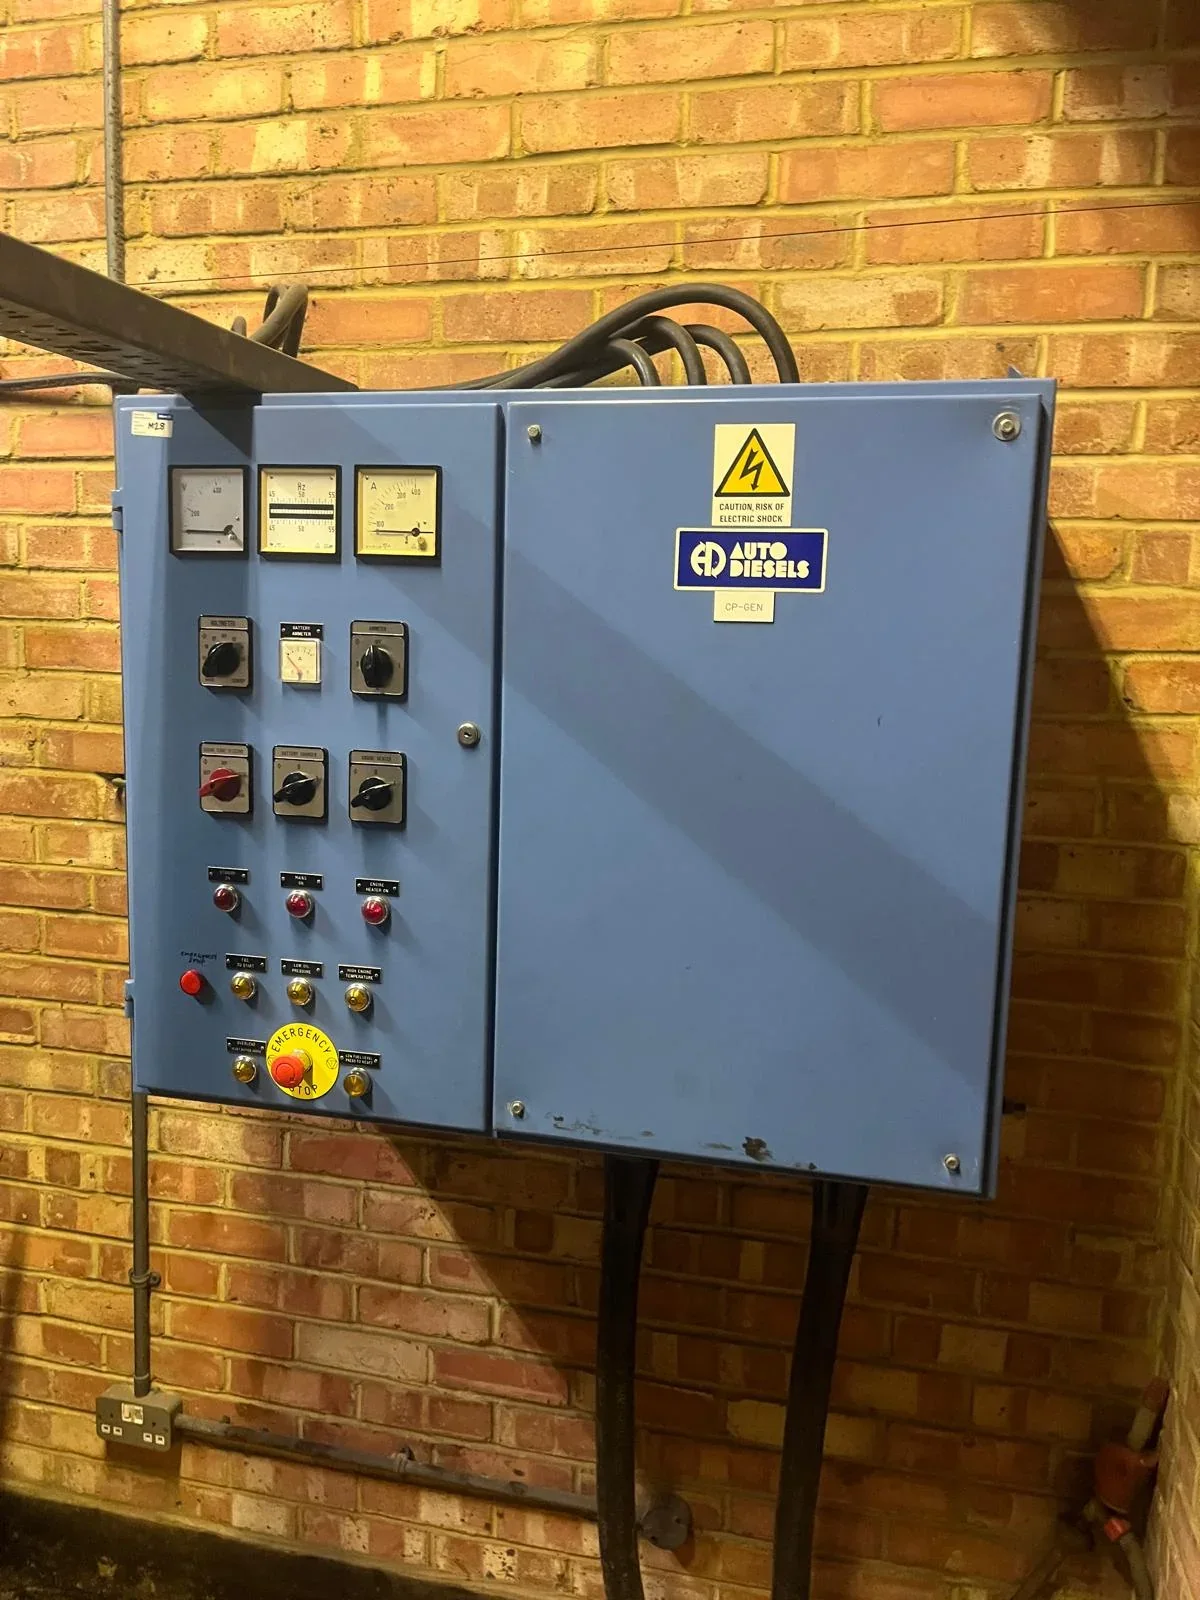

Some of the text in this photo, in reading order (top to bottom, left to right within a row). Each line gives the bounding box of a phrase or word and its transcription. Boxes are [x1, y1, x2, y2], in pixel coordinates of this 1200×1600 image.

[370, 481, 377, 490] A
[719, 502, 785, 512] CAUTION, RISK OF
[719, 515, 783, 523] ELECTRIC SHOCK
[729, 541, 788, 560] AUTO
[729, 560, 810, 579] DIESELS
[724, 602, 764, 612] CP-GEN
[345, 973, 374, 981] TEMPERATURE
[271, 1027, 332, 1054] EMERGENCY
